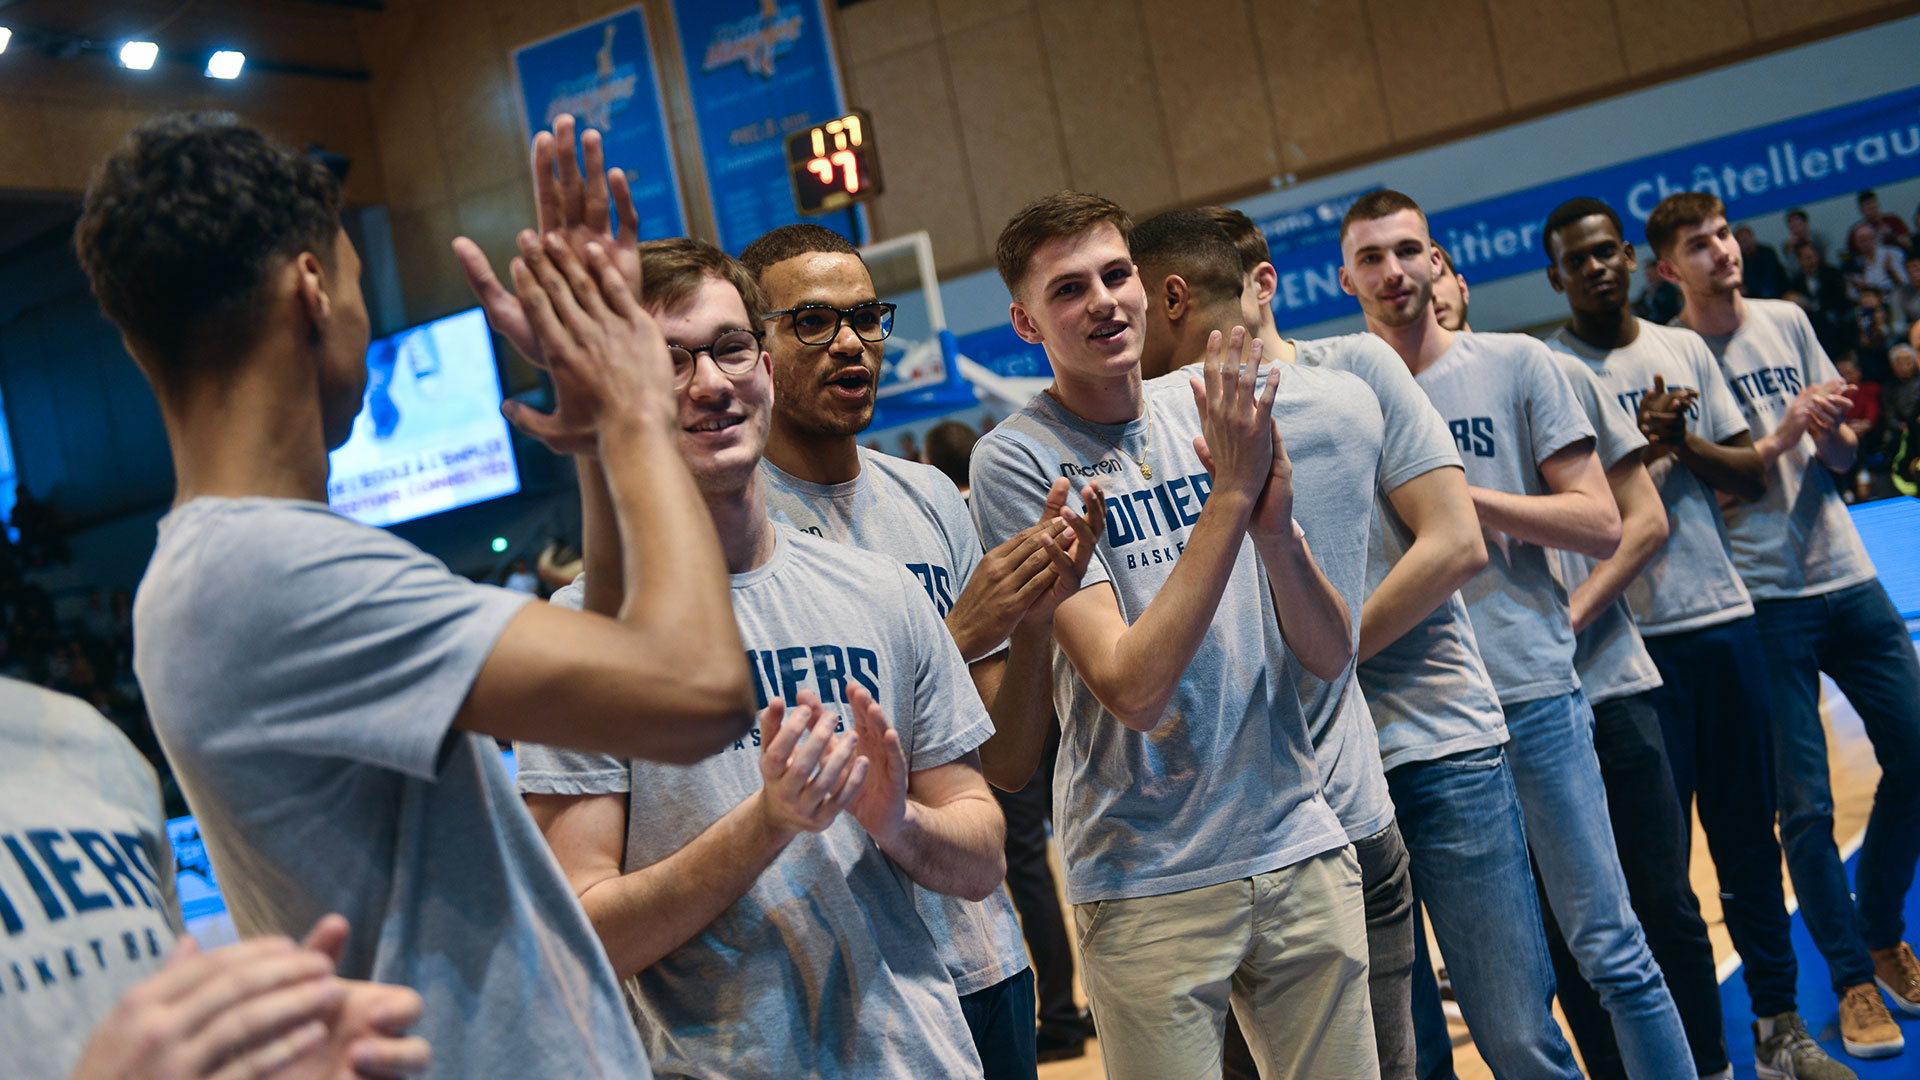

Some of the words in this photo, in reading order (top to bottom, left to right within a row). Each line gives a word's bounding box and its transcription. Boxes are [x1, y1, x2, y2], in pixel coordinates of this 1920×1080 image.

[1449, 217, 1547, 267] itier
[1082, 472, 1213, 548] OITIER
[1127, 541, 1185, 569] BASKE
